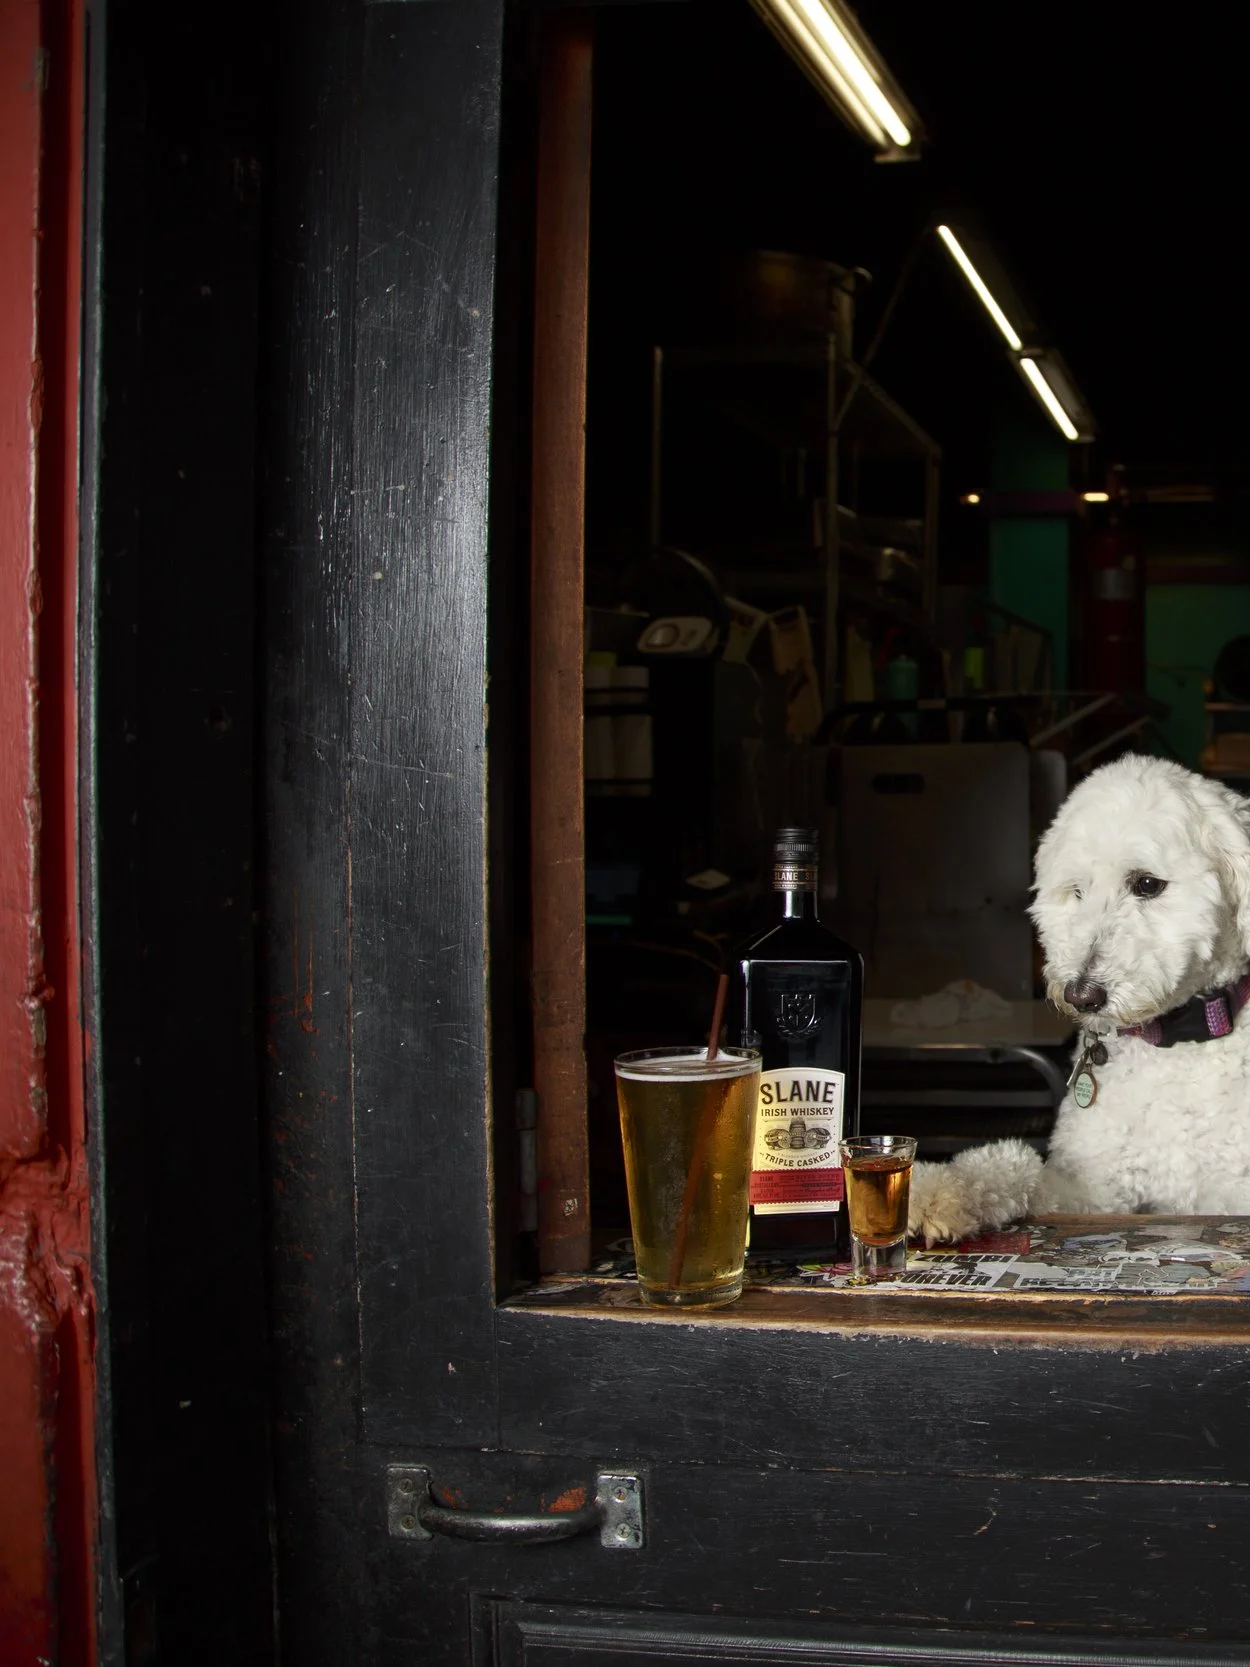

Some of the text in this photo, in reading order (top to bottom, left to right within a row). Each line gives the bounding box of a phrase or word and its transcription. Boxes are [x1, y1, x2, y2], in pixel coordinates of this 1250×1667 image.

[759, 1079, 836, 1105] SLANE
[761, 1107, 835, 1117] IRISH WHISKEY
[765, 1151, 831, 1167] TRIPLE CASKED
[899, 1272, 993, 1286] OREVER
